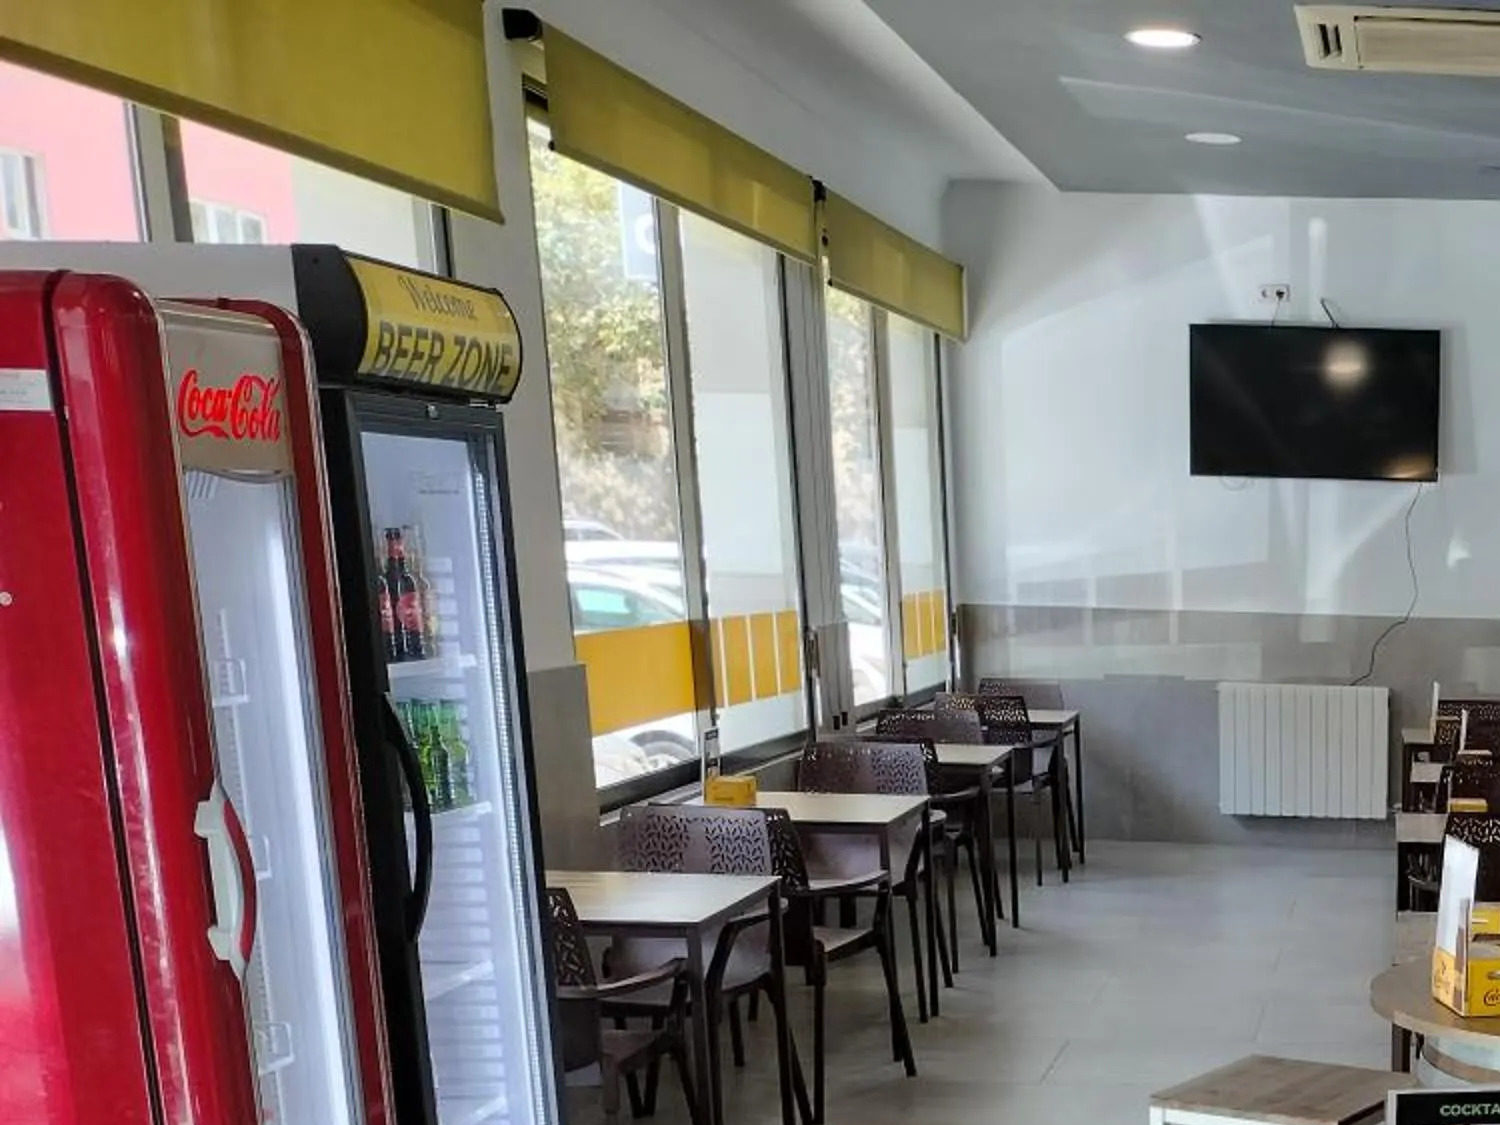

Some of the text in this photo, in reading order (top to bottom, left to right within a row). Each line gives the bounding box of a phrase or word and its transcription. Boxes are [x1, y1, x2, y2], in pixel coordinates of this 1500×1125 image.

[397, 274, 478, 319] Welcome
[369, 320, 513, 392] BEER ZONE
[178, 369, 282, 441] Coca-Cola
